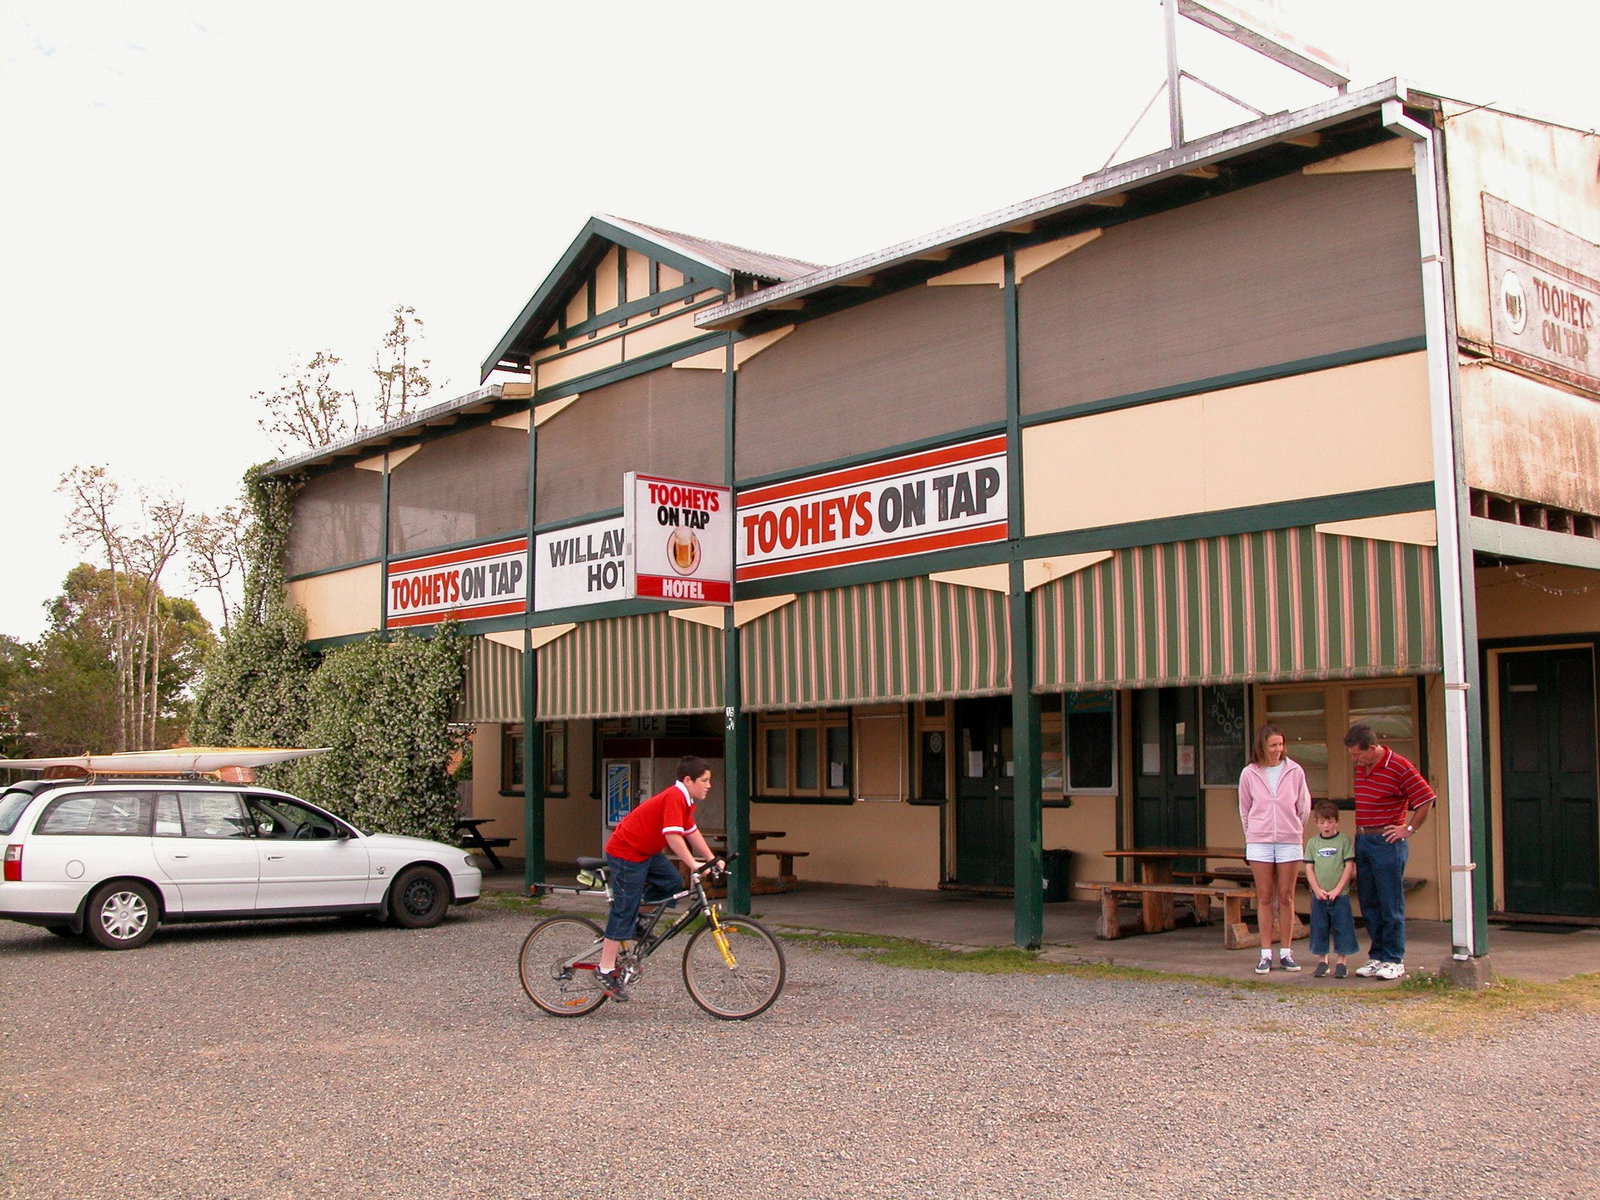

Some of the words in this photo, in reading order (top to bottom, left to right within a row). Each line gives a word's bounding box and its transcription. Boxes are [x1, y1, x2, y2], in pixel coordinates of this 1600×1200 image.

[1533, 276, 1593, 331] TOOHEYS
[1542, 320, 1562, 354] ON
[1564, 328, 1588, 361] TAP
[648, 483, 719, 512] TOOHEYS
[743, 491, 872, 556] TOOHEYS
[878, 480, 925, 533] ON
[932, 467, 1000, 522] TAP
[657, 506, 680, 527] ON
[682, 509, 710, 530] TAP
[392, 570, 460, 610] TOOHEYS
[461, 568, 486, 601] ON
[489, 560, 523, 596] TAP
[588, 561, 625, 592] HOT
[662, 578, 705, 599] HOTEL
